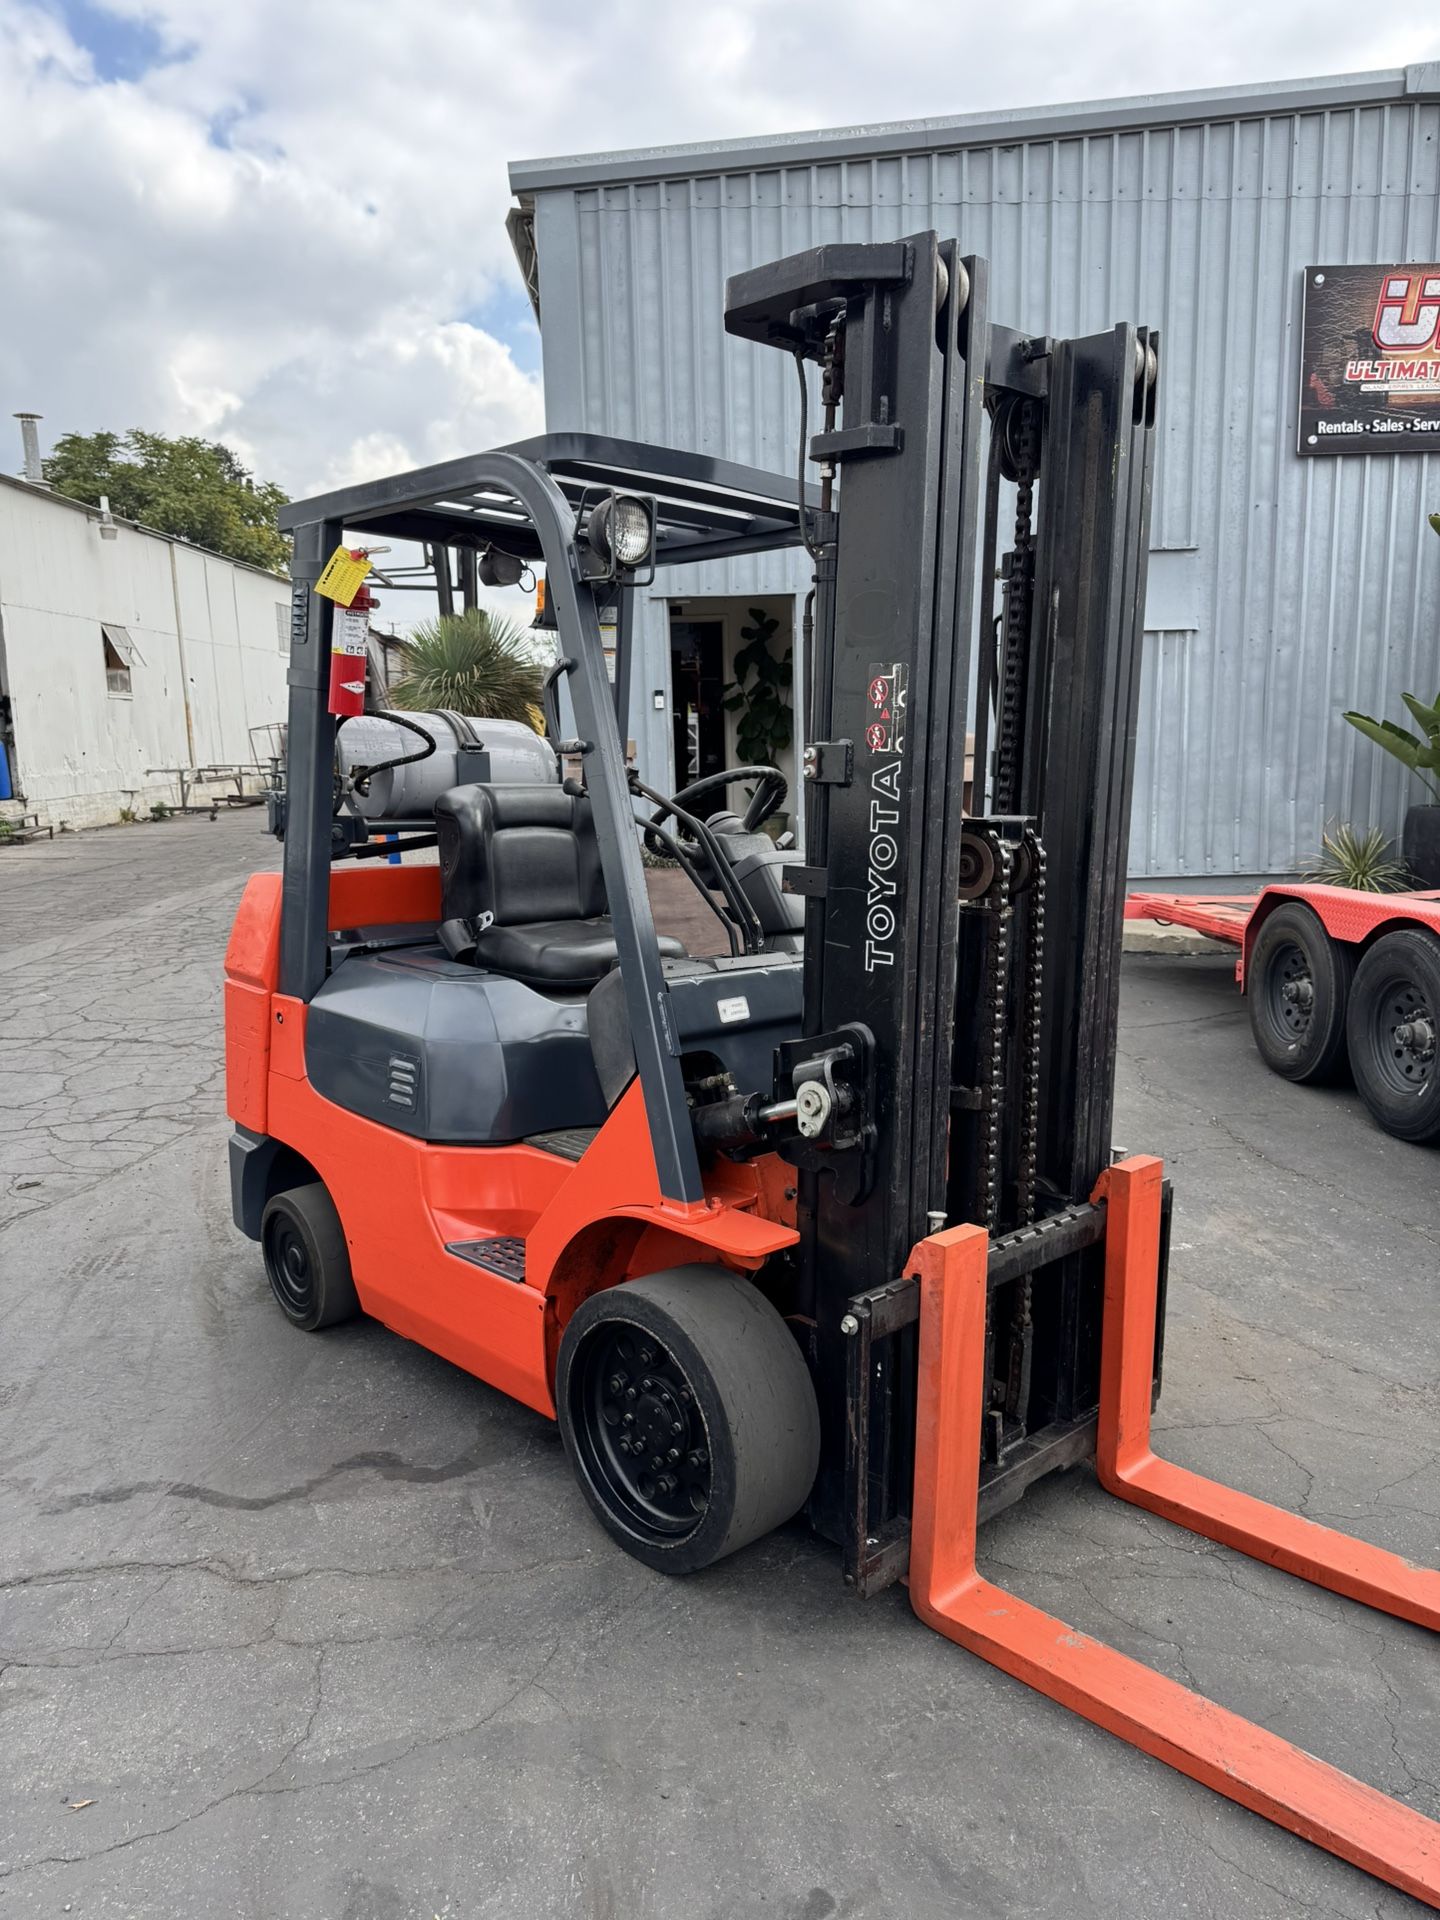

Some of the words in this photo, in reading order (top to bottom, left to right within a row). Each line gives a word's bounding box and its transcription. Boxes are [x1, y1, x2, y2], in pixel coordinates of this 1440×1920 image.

[1318, 420, 1364, 434] Rentals
[1372, 418, 1404, 432] Sales
[1412, 417, 1440, 431] Serv
[865, 760, 902, 973] TOYOTA
